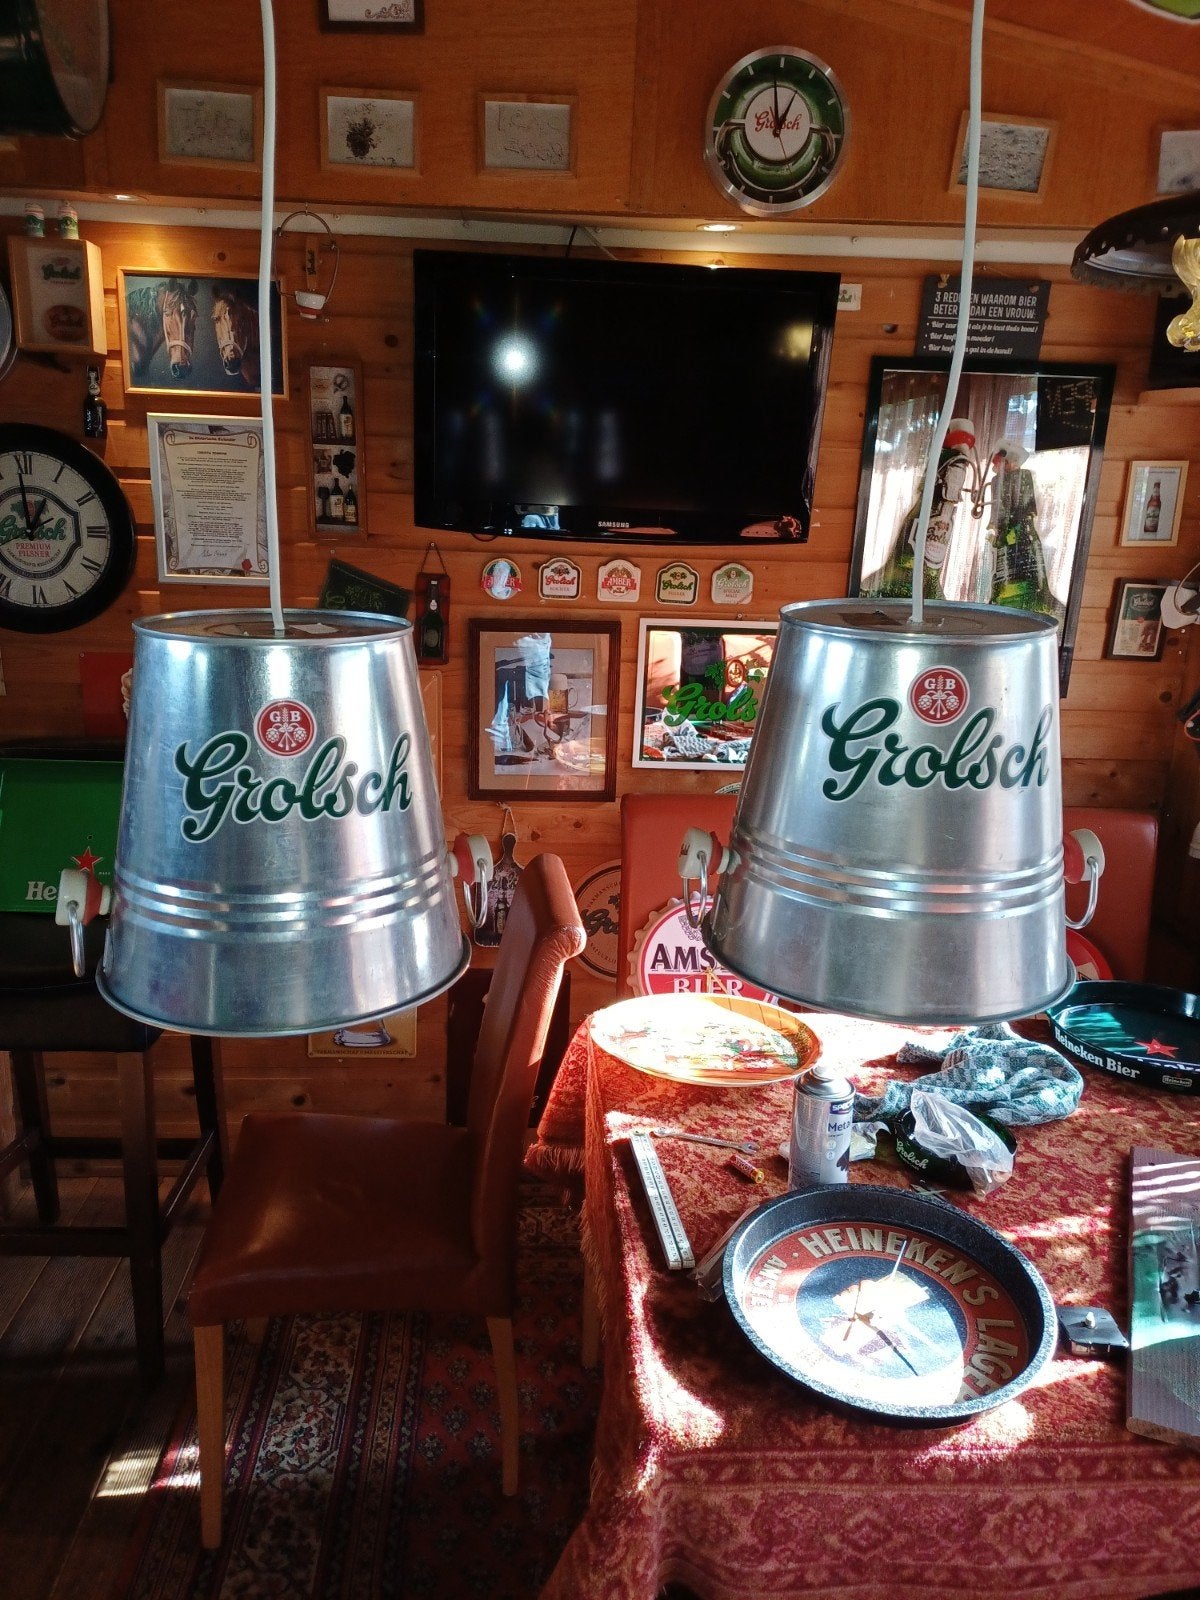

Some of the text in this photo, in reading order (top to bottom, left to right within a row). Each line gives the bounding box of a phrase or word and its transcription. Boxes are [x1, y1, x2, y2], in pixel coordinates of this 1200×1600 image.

[754, 111, 802, 132] Grosch
[935, 291, 941, 302] 3
[981, 293, 1017, 306] WAAROM
[1018, 296, 1037, 307] BIER
[933, 303, 958, 315] BETER
[970, 306, 986, 317] DAN
[988, 306, 1004, 317] EEN
[598, 521, 630, 529] SAMSUNG
[15, 542, 51, 550] PREMIUM
[18, 550, 50, 558] PILSNER
[545, 575, 577, 586] Grolsch
[607, 577, 632, 587] AMBER
[662, 579, 694, 591] Grolsch
[716, 577, 748, 590] Grolsch
[662, 683, 759, 727] Grols
[821, 696, 1053, 801] Grolsch
[174, 730, 413, 843] Grolsch
[651, 943, 717, 970] AMS
[1054, 1026, 1141, 1079] Heineken Bier
[896, 1139, 929, 1170] Grolsch
